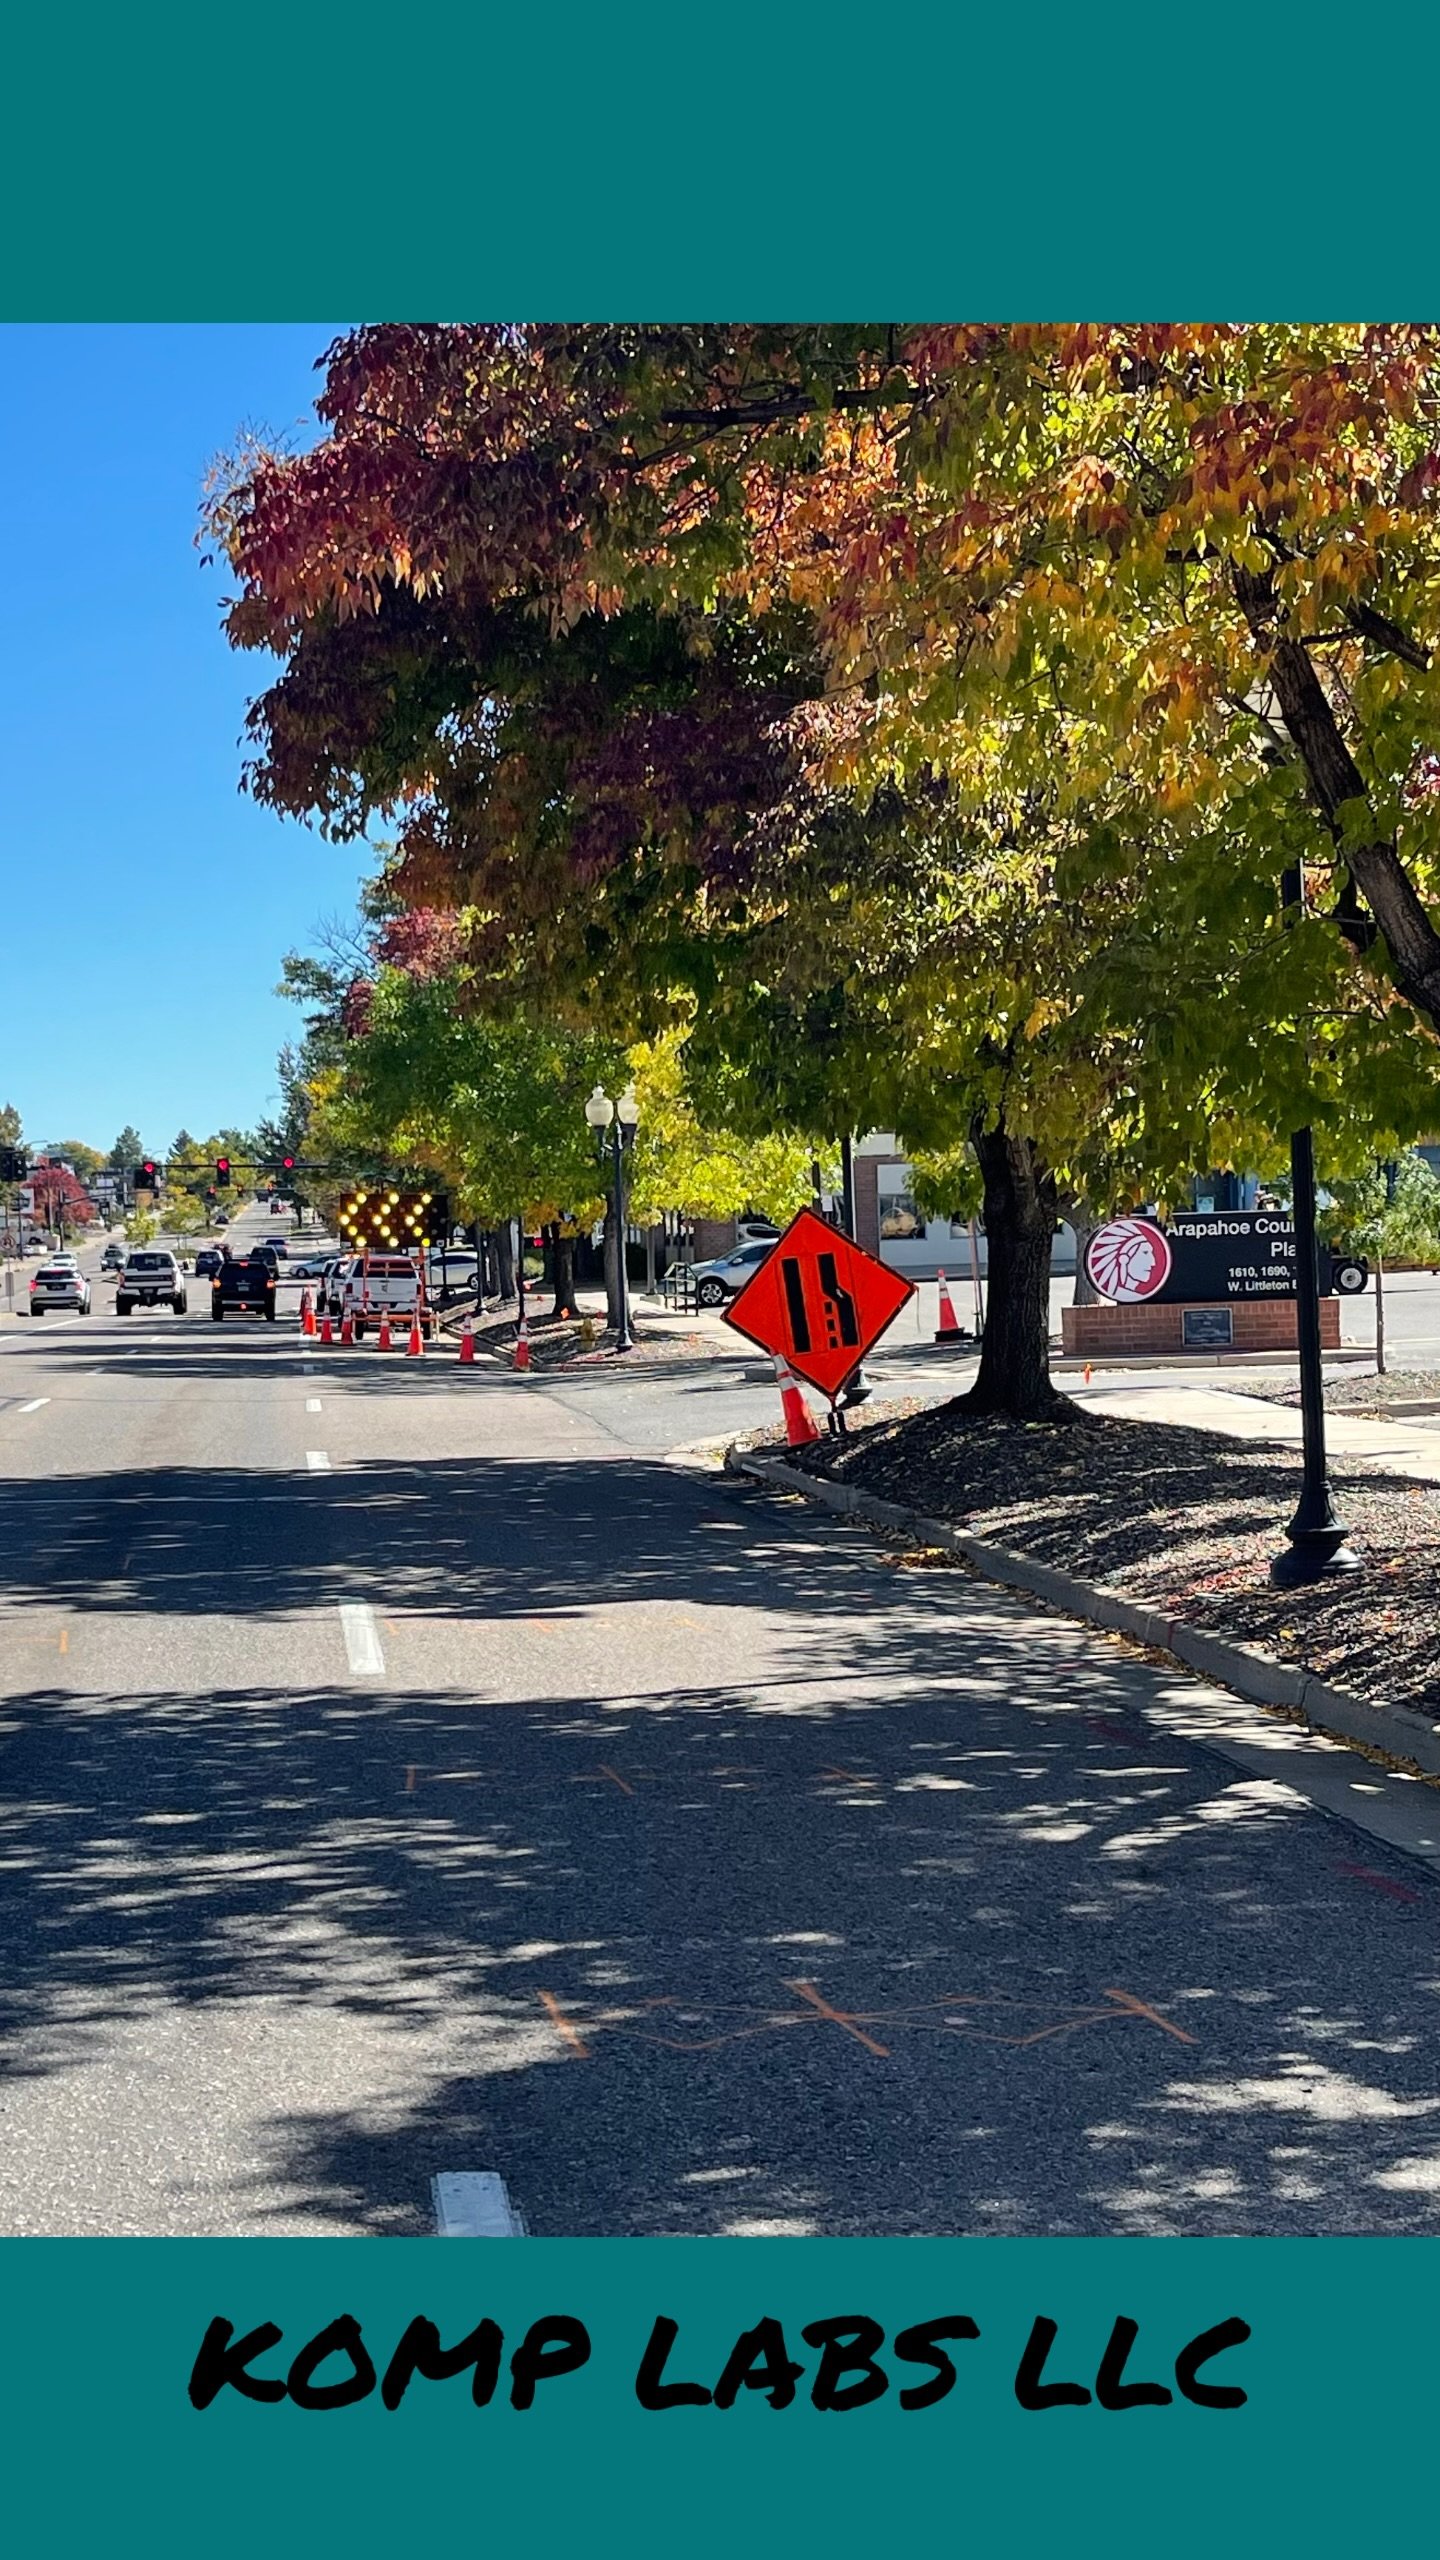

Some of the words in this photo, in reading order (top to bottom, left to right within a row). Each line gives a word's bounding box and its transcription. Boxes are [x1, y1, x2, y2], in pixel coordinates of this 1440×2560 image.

[1166, 1220, 1251, 1240] Arapahoe
[1228, 1266, 1259, 1278] 1610,
[1227, 1281, 1243, 1292] W.
[1245, 1280, 1290, 1291] Littleton
